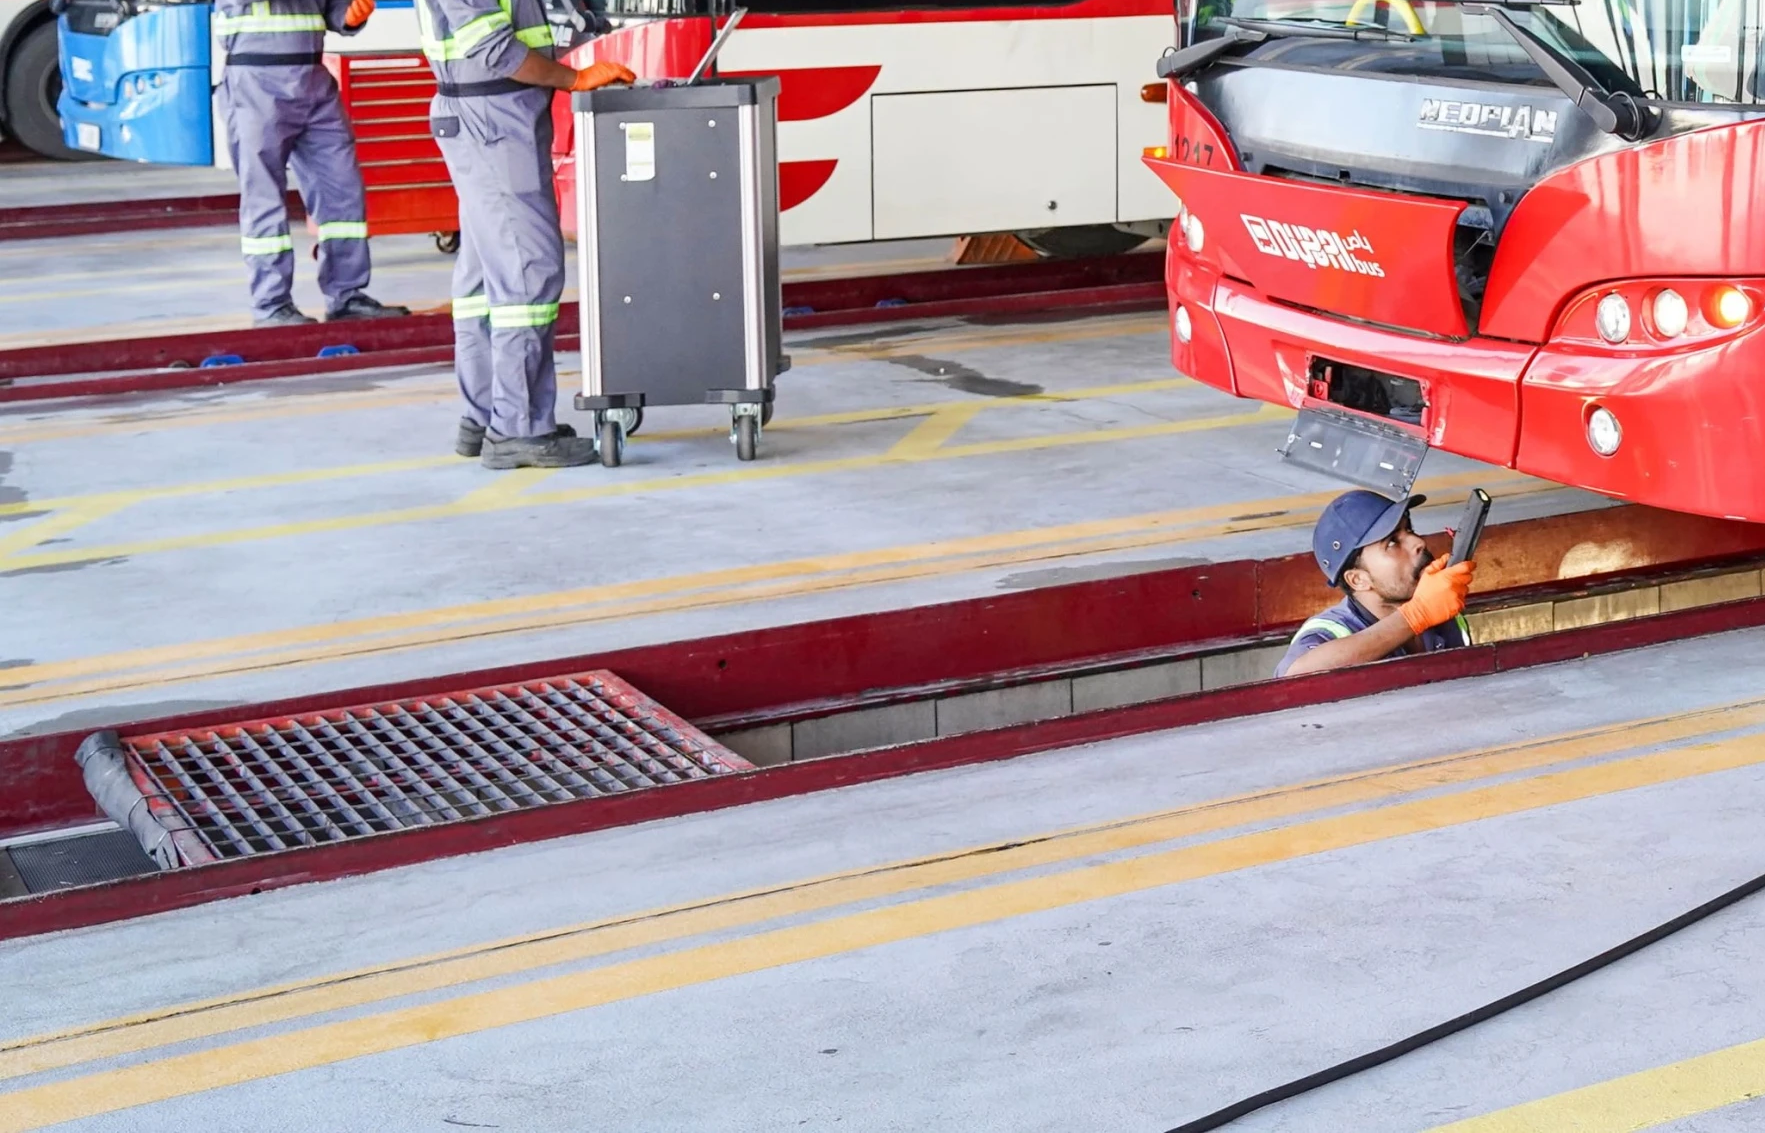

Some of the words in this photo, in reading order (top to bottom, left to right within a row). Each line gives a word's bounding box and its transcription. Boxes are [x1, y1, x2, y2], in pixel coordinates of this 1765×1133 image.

[1419, 97, 1559, 140] NEOPLAN
[1174, 133, 1214, 167] 1217
[1349, 252, 1386, 278] bus
